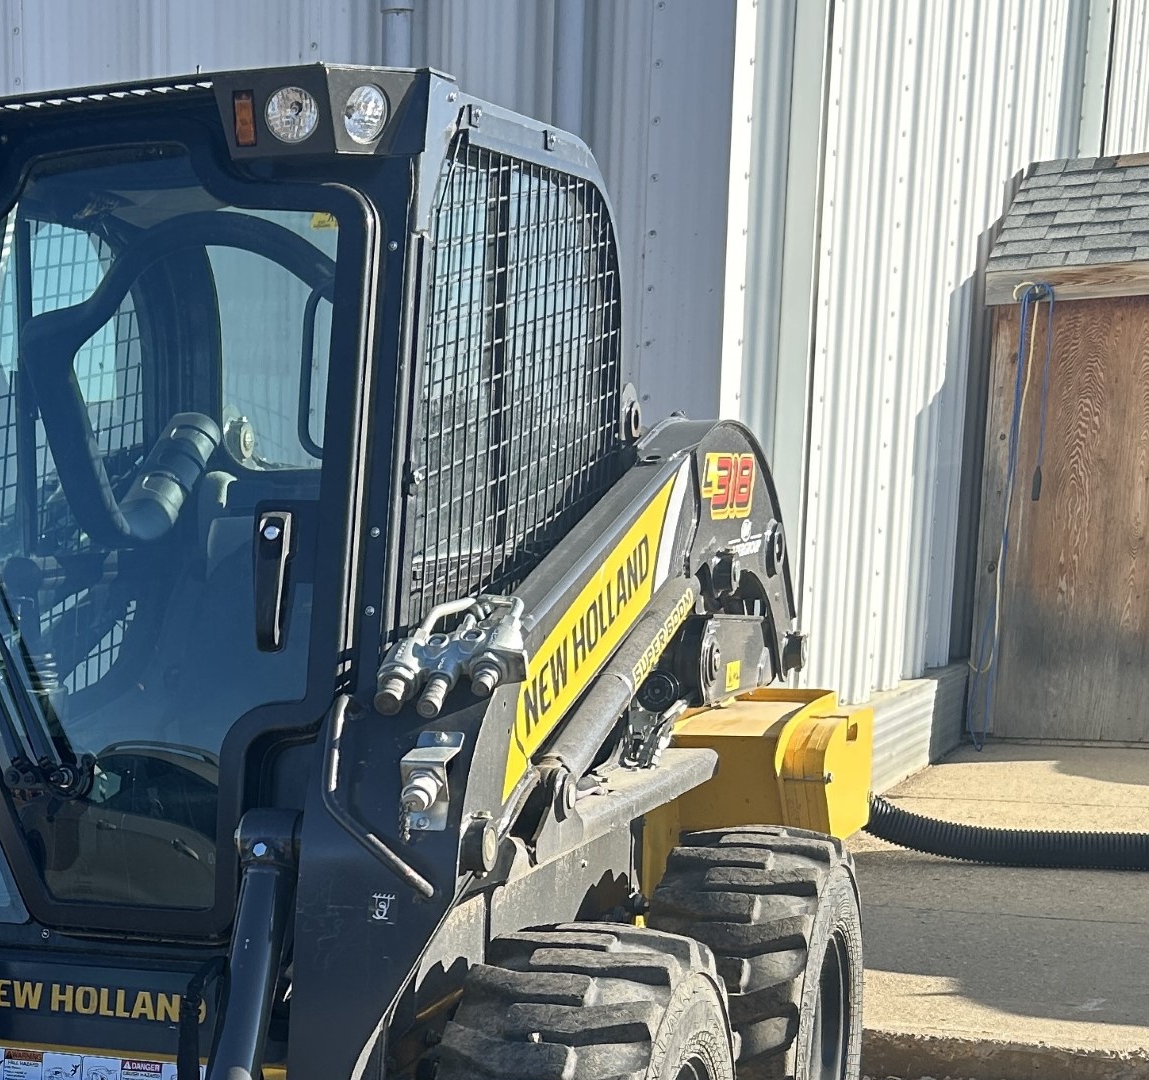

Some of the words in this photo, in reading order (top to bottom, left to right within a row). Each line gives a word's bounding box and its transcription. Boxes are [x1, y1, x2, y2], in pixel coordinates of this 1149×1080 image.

[702, 453, 755, 519] L318
[523, 635, 568, 738] NEW
[572, 533, 650, 674] HOLLAND
[633, 628, 667, 690] SUPER
[12, 1051, 42, 1061] WARNING
[131, 1062, 160, 1072] DANGER
